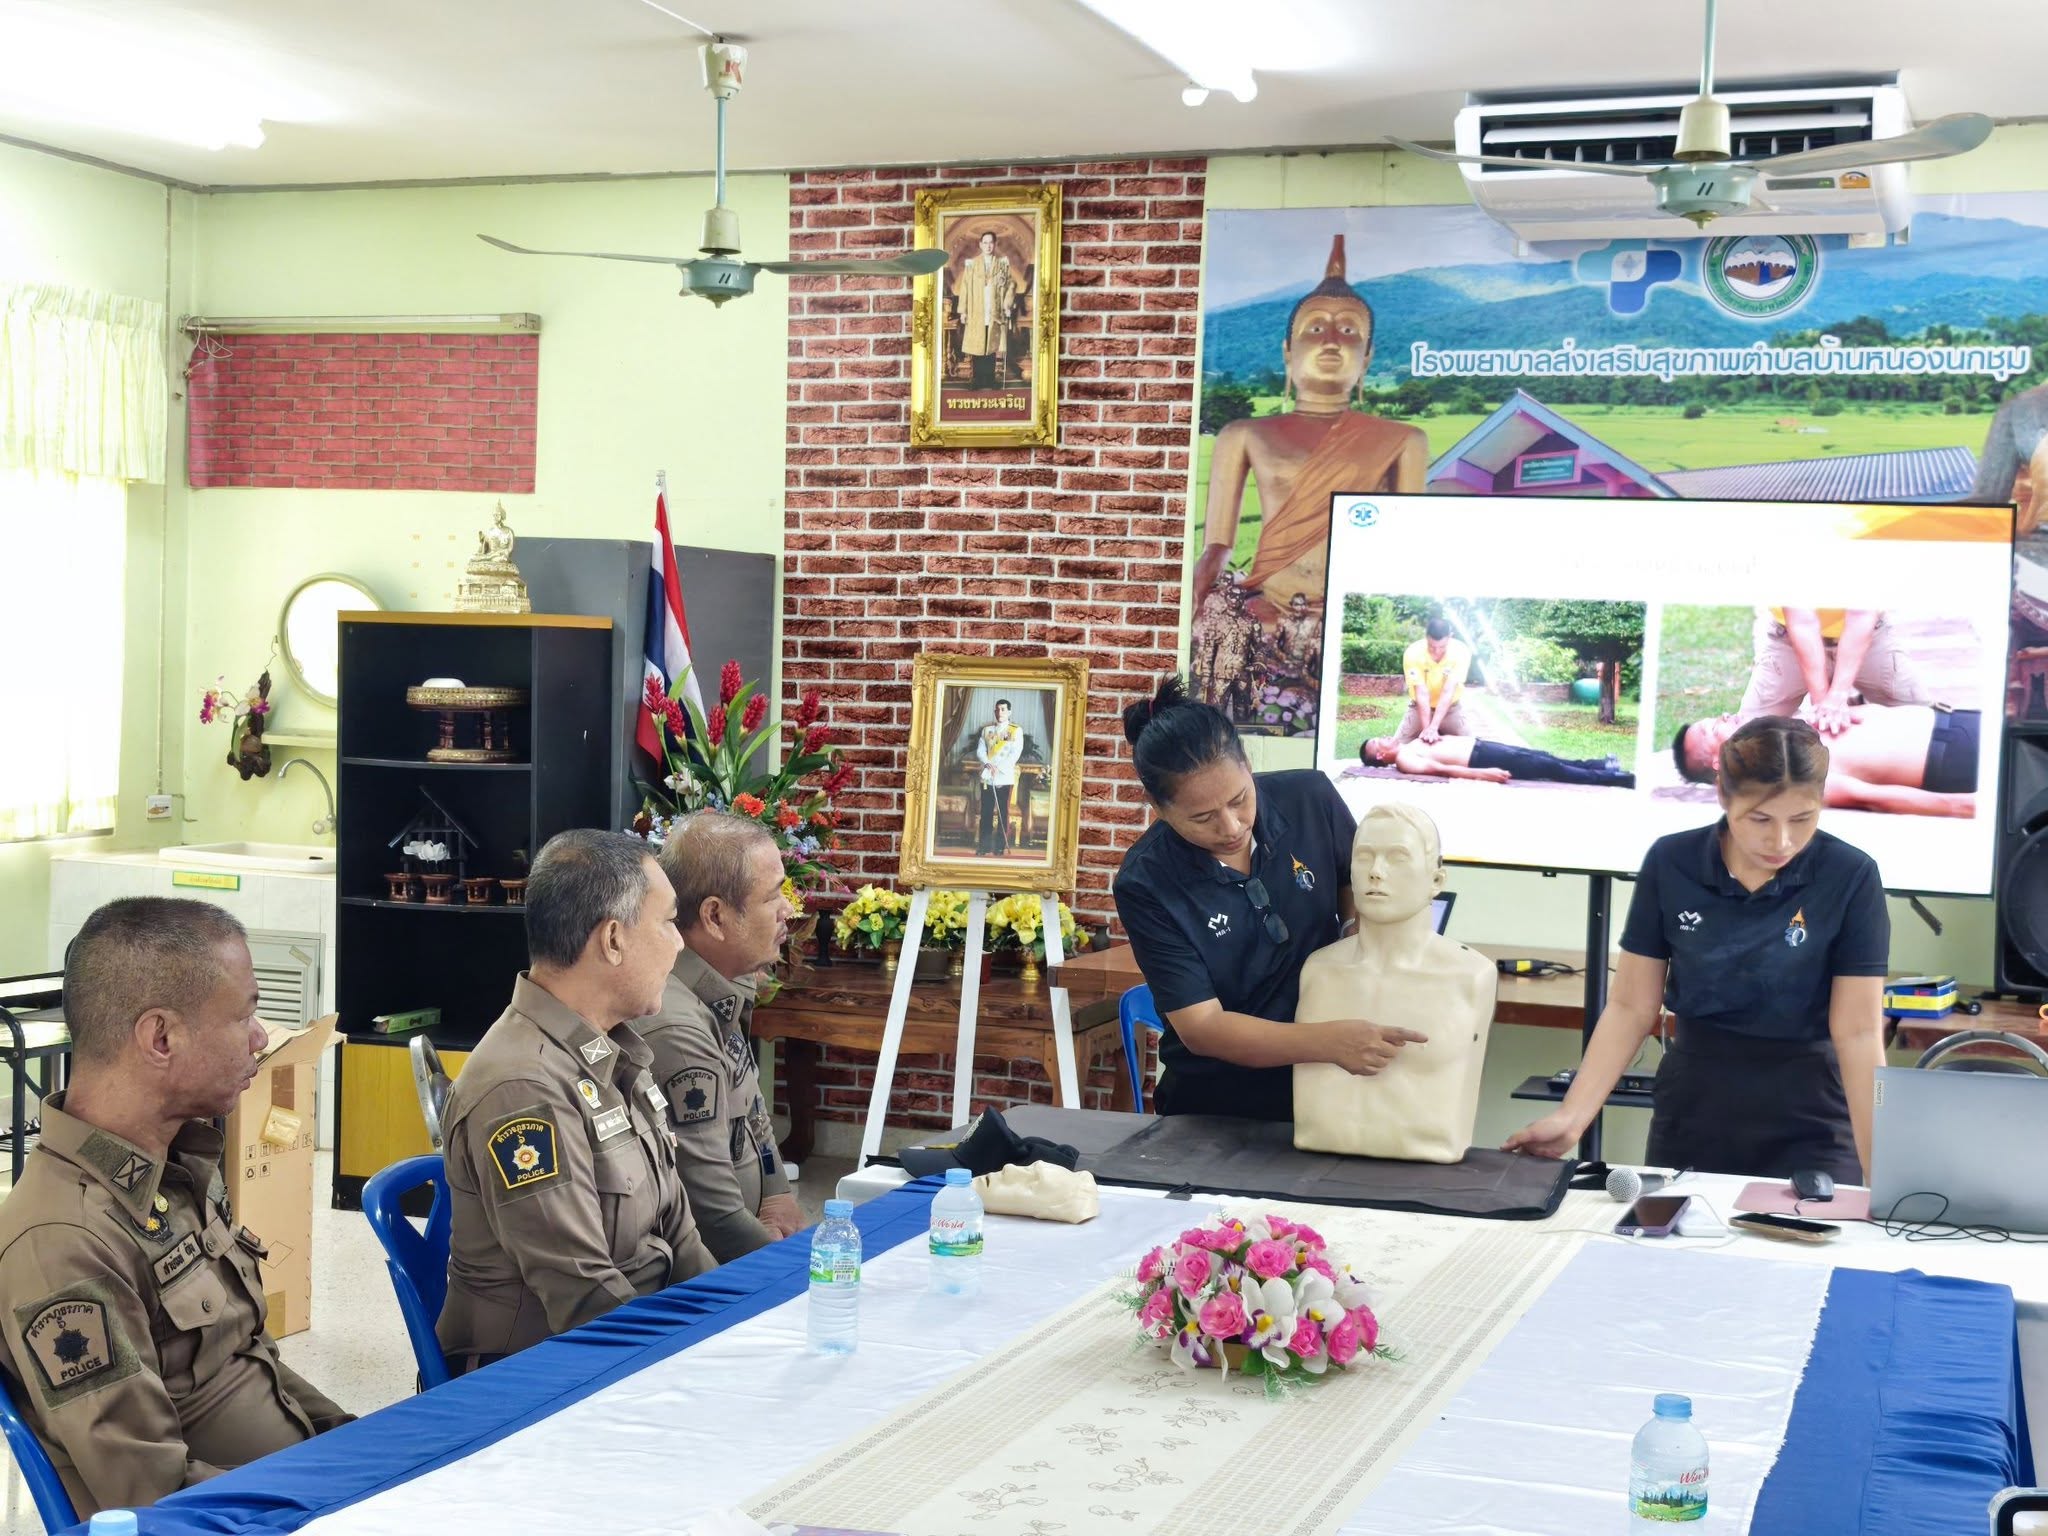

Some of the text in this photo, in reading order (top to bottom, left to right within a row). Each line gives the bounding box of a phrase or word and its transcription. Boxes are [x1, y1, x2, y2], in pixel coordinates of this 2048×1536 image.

[1411, 336, 2030, 381] โรงพยาบาลส่งเสริมสุขภาพตำบลบ้านหนองนกชุม
[946, 393, 1026, 411] ทรงพระเจริญ
[683, 1109, 711, 1121] POLICE
[517, 1167, 546, 1183] POLICE
[30, 1303, 94, 1339] ตำรวจภูธรภาค
[60, 1356, 102, 1381] POLICE
